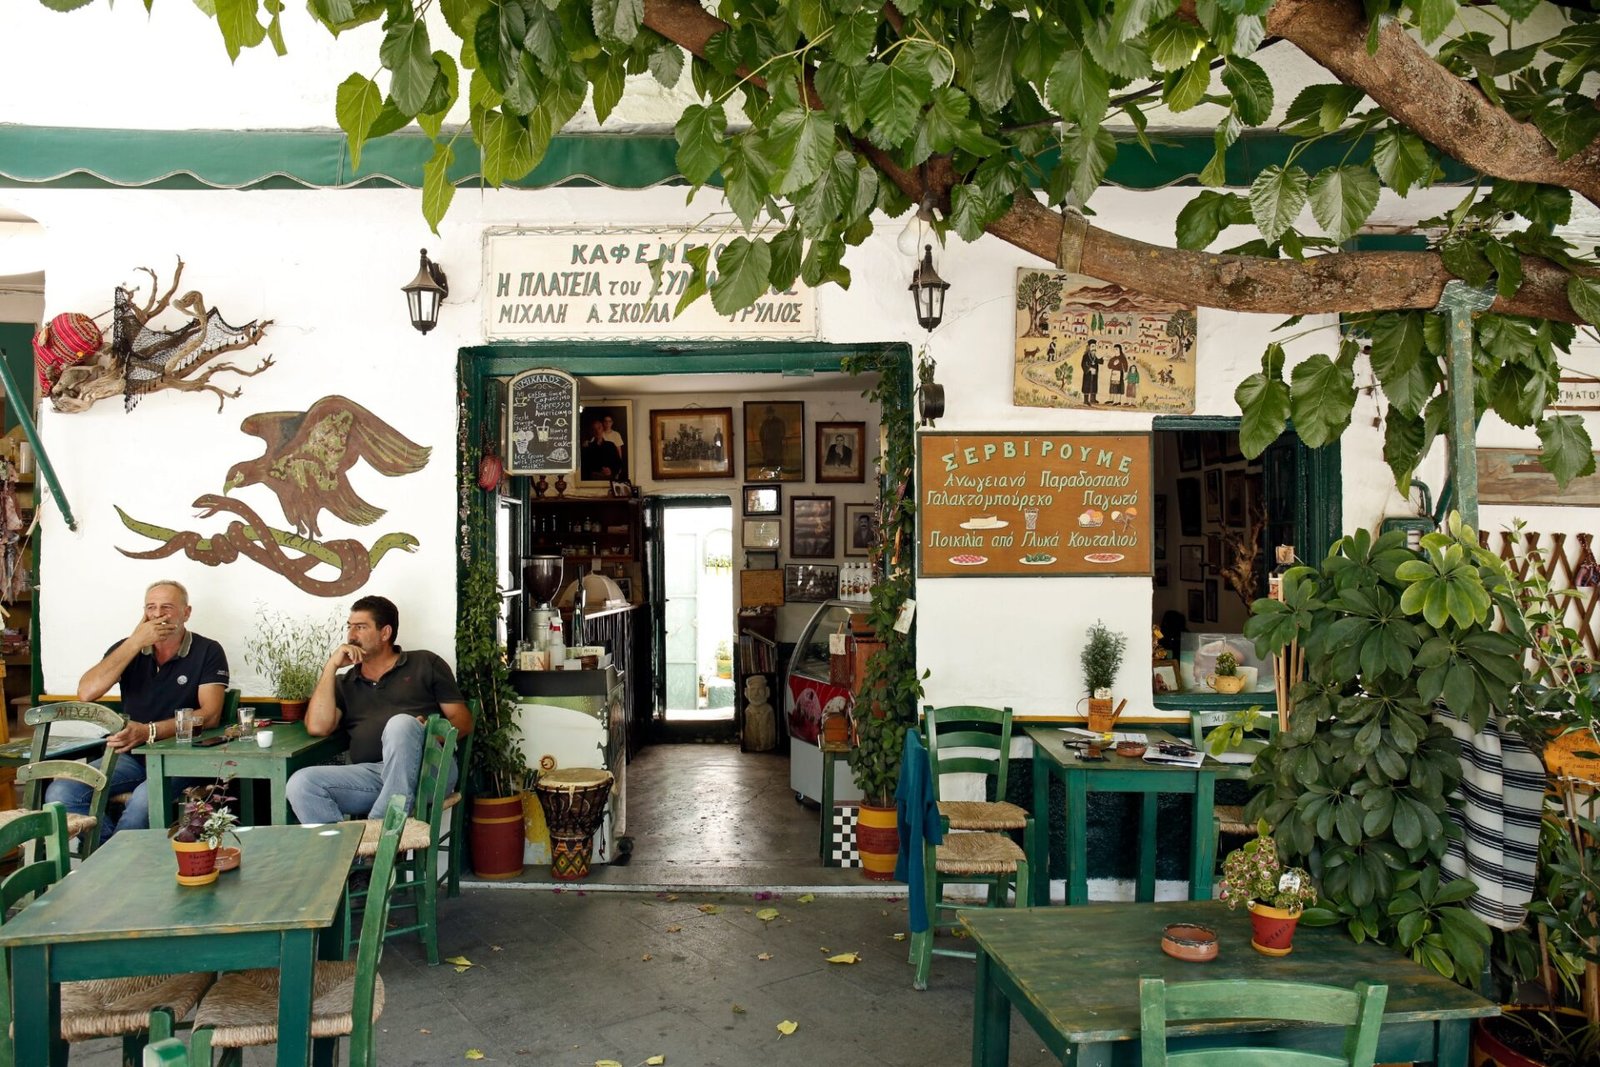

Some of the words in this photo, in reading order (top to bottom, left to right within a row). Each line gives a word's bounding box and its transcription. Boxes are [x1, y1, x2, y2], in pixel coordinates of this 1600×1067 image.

[496, 272, 511, 297] Η
[518, 272, 602, 296] ΠΛΑΤΕΙΑ
[608, 281, 641, 295] του
[498, 304, 568, 323] ΜΙΧΑΛΗ
[608, 303, 670, 323] ΣΚΟΥΛΑ
[941, 440, 1132, 473] ΣΕΡΒΙΡΟΥΜΕ
[944, 471, 1026, 492] Ανωγειανό
[1040, 470, 1130, 492] Παραδοσιακό
[926, 490, 1052, 511] Γαλακτομπούρεκο
[1082, 490, 1137, 511] Παγωτό
[928, 531, 984, 547] Ποικιλία
[991, 531, 1014, 547] από
[1021, 531, 1060, 547] Γλυκά
[1068, 530, 1137, 547] Κουταλιού
